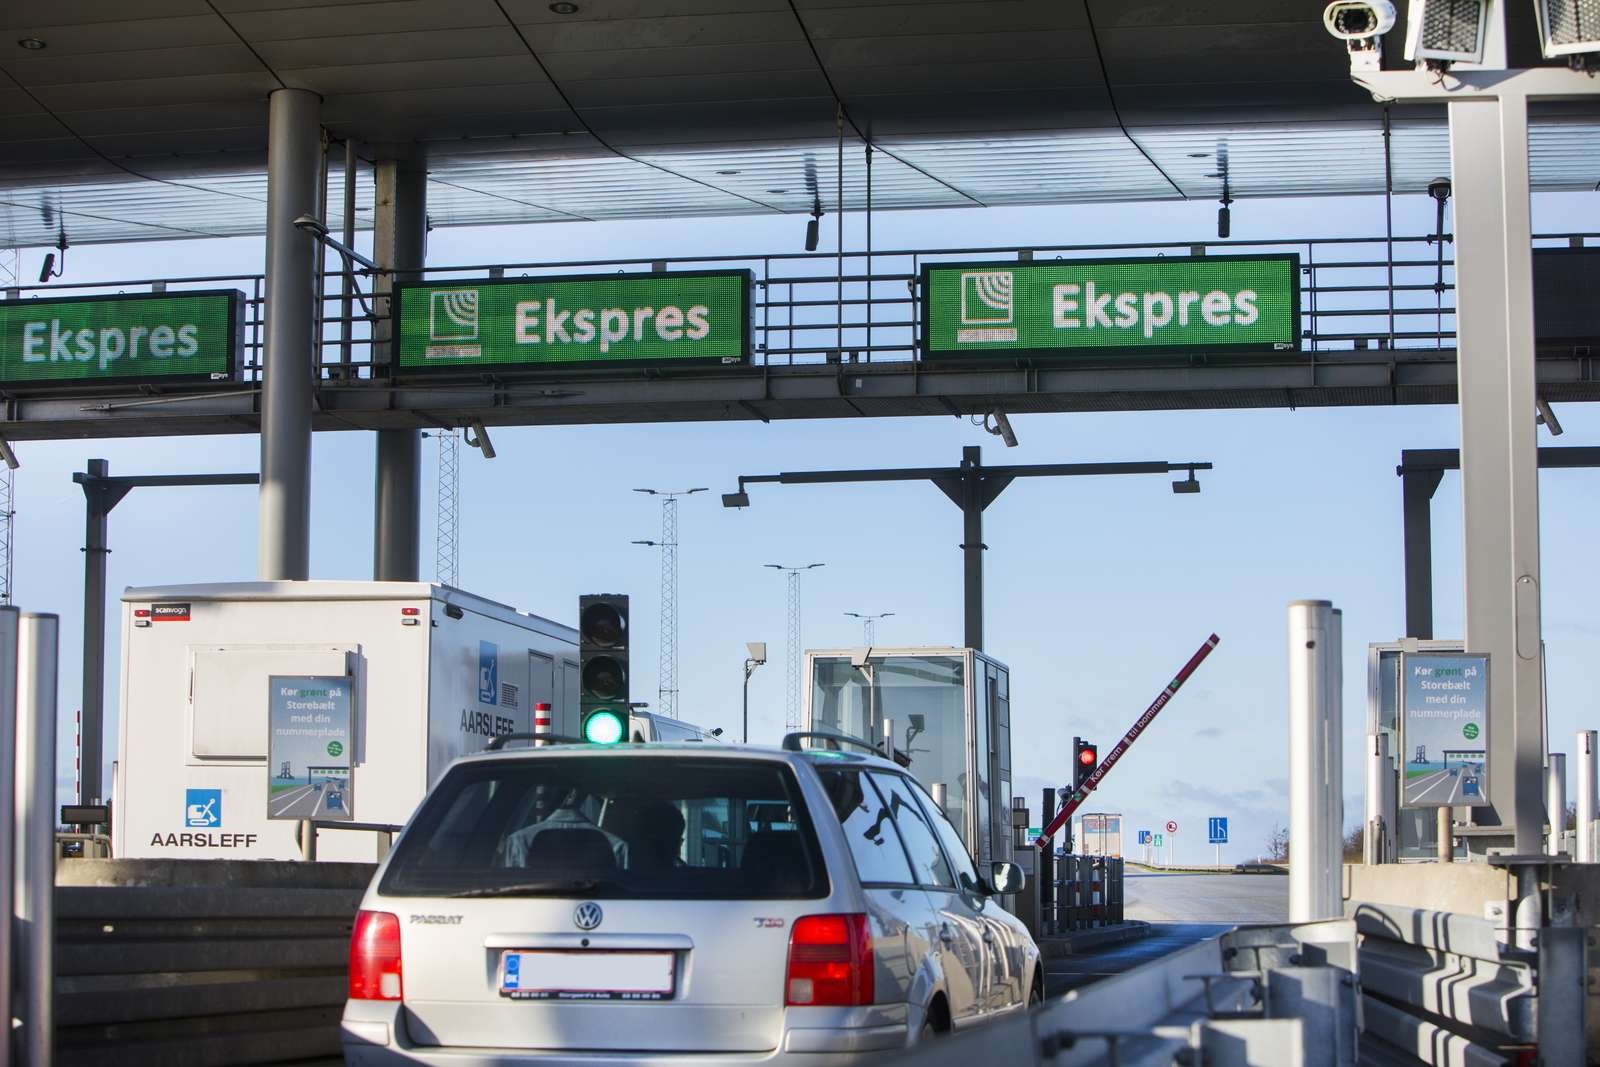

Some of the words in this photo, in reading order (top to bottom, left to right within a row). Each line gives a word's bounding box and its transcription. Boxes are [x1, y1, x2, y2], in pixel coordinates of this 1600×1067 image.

[1052, 281, 1258, 338] Ekspres
[514, 298, 710, 353] Ekspres
[22, 318, 199, 369] Ekspres
[1414, 666, 1433, 676] Kør
[1434, 667, 1462, 678] grønt
[1464, 665, 1477, 679] på
[1420, 680, 1471, 690] Storebælt
[280, 687, 298, 697] Kør
[329, 687, 342, 699] på
[287, 700, 336, 710] Storebælt
[1425, 695, 1448, 704] med
[1449, 695, 1466, 704] din
[1137, 693, 1168, 728] bommen
[1409, 708, 1481, 720] nummerplade
[290, 713, 313, 723] med
[314, 713, 331, 723] din
[275, 727, 345, 738] nummerplade
[150, 832, 258, 848] AARSLEFF
